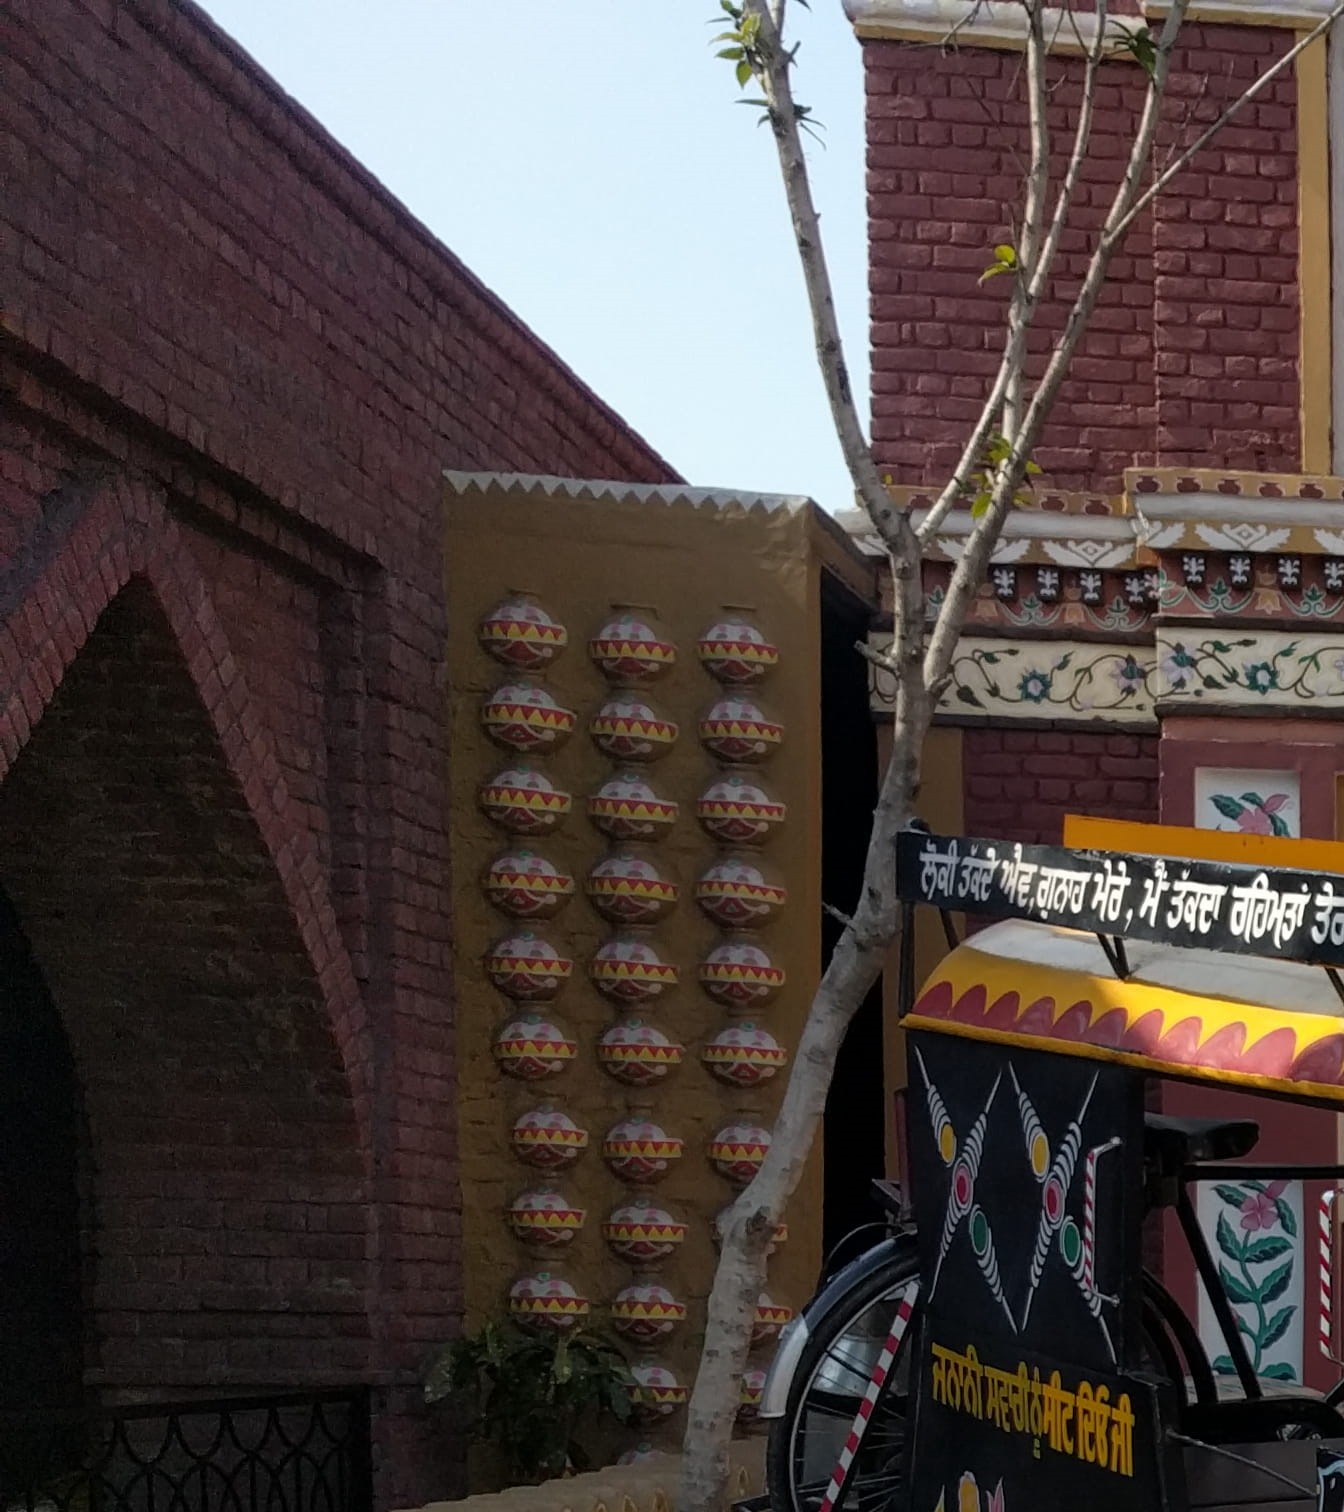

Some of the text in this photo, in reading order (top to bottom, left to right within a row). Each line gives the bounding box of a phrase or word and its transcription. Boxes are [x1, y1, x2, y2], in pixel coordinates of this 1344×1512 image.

[1167, 869, 1228, 934] ਤੱਕਦਾ
[1229, 872, 1311, 949] ਰਹਿਮਤਾਂ
[1043, 1370, 1075, 1455] ਸੀਟ
[1110, 1393, 1135, 1477] ਜੀ
